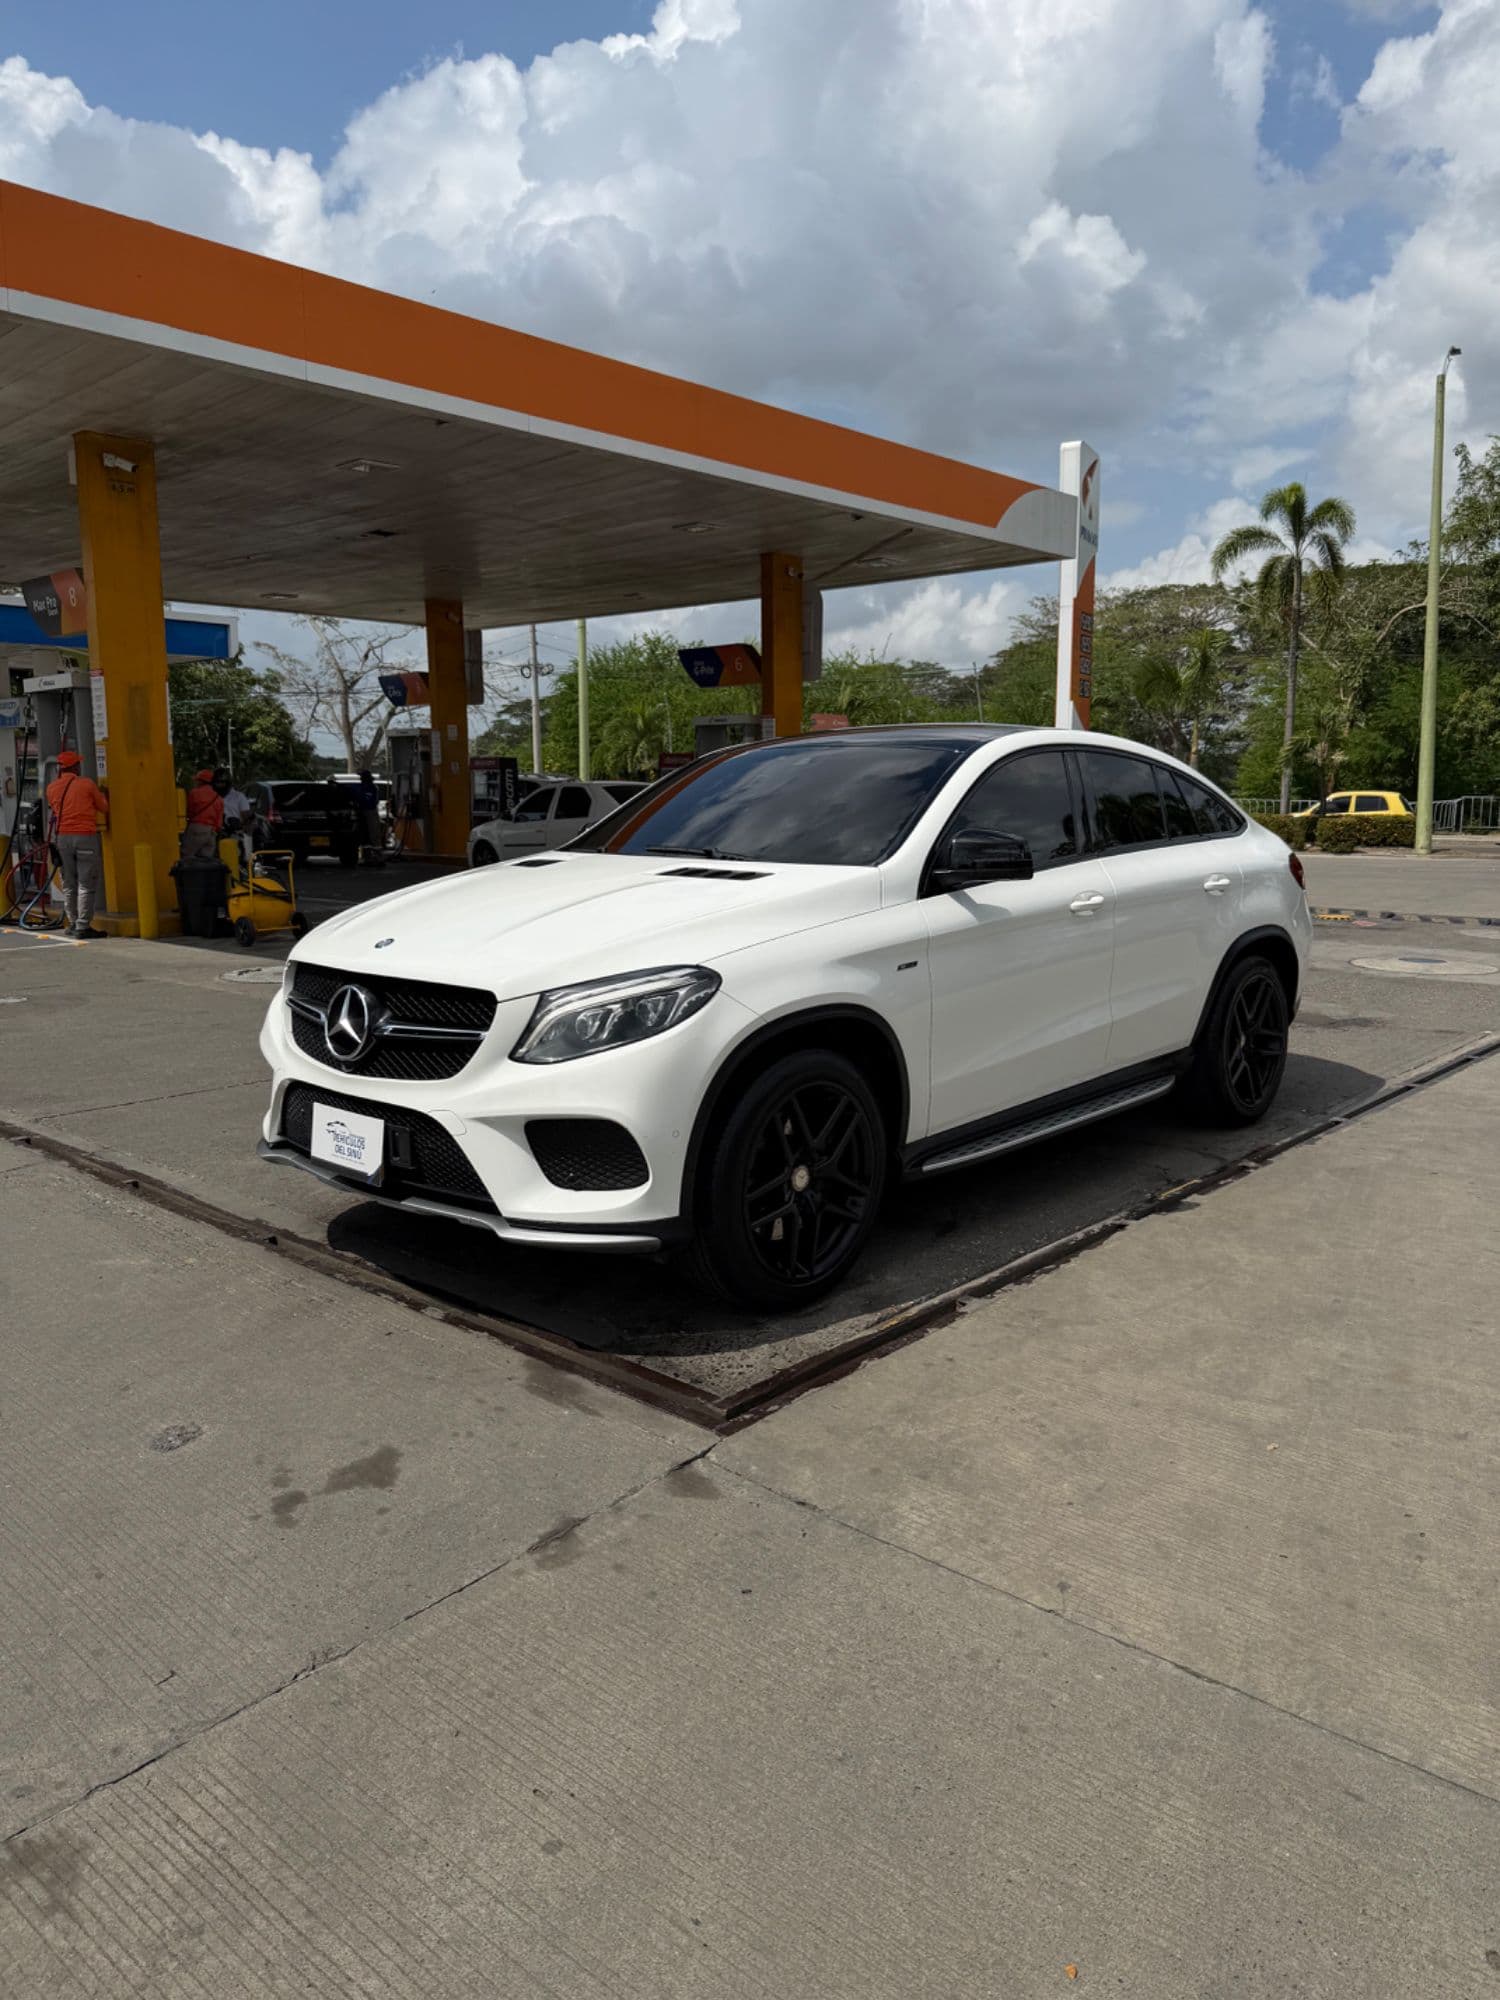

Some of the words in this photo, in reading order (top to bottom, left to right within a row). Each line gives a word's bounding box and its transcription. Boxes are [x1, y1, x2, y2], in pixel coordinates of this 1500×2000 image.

[69, 586, 76, 607] 8
[735, 656, 743, 672] 6
[334, 1144, 346, 1155] DEL
